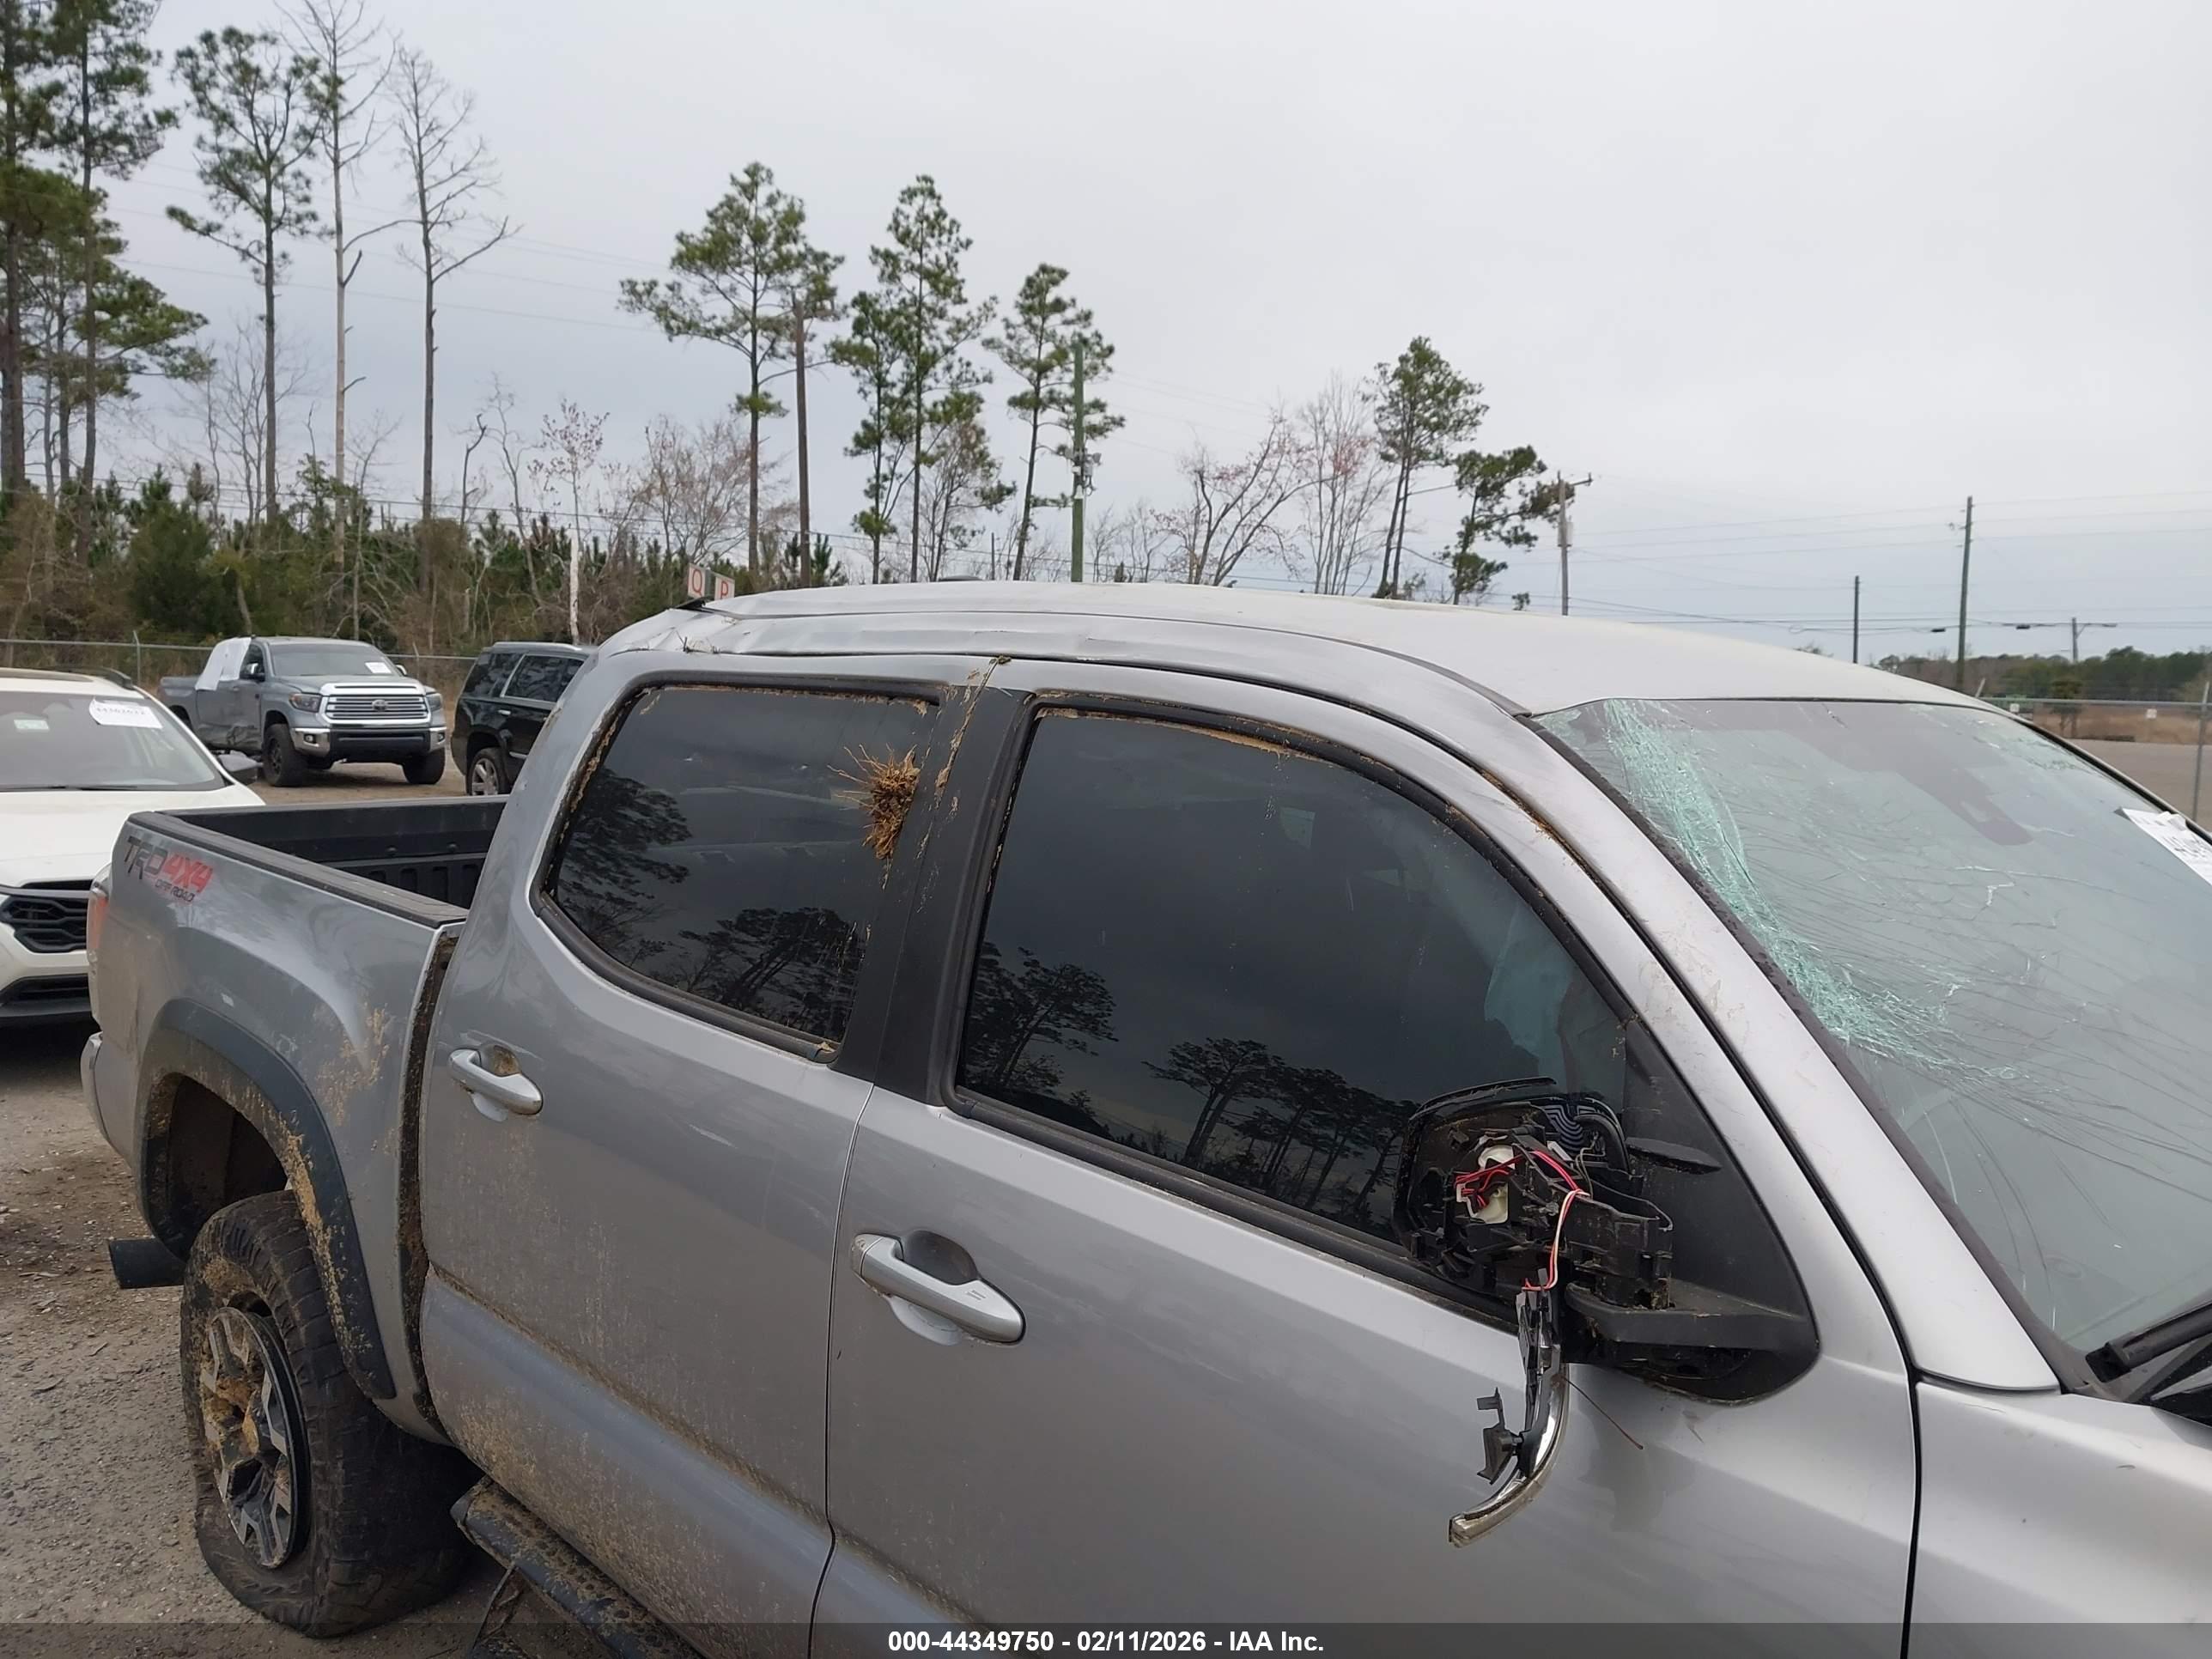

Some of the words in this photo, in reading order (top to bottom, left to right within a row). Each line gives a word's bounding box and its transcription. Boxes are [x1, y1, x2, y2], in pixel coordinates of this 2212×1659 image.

[692, 568, 702, 597] Q
[124, 836, 169, 880] TRD
[155, 878, 173, 892] OFF
[170, 885, 196, 902] ROAD
